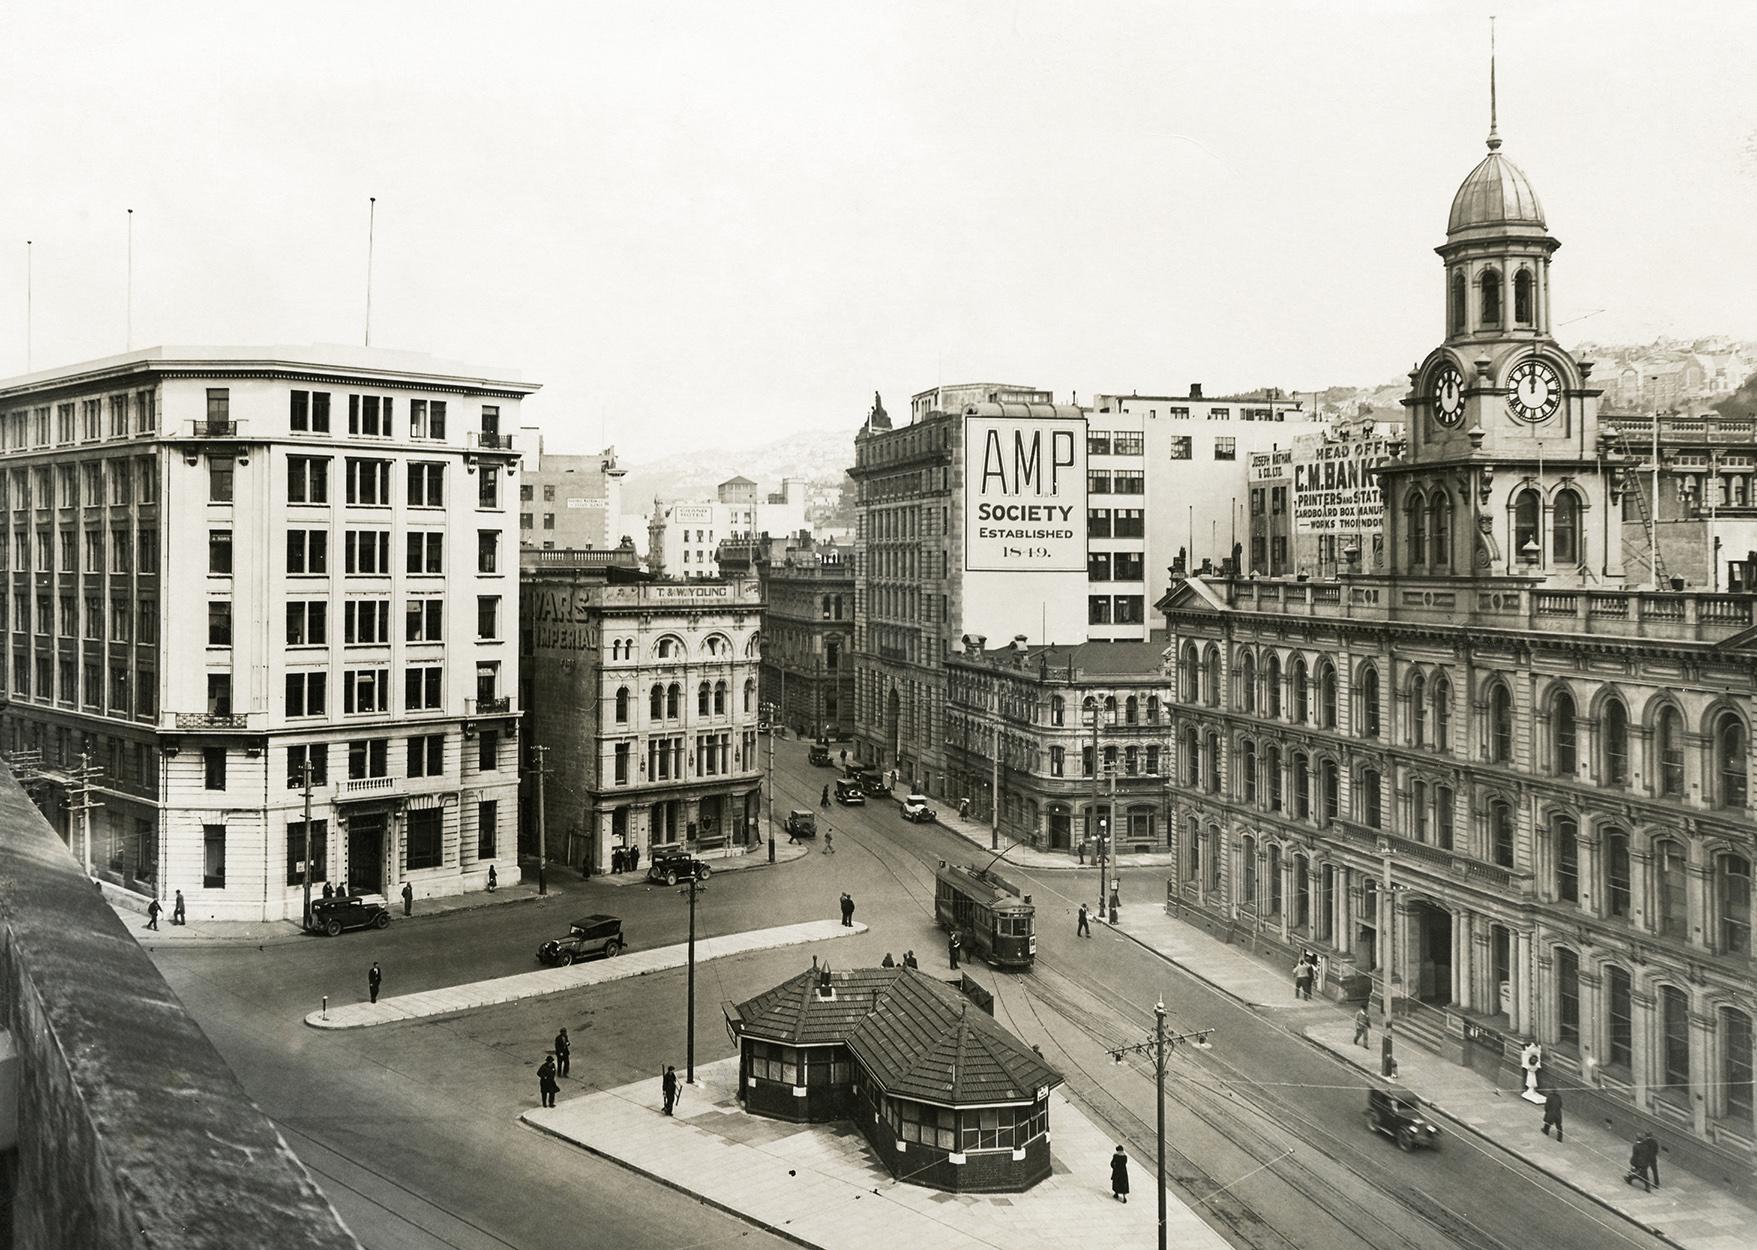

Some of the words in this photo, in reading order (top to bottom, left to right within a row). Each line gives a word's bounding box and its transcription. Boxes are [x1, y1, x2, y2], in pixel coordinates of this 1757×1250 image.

[1316, 446, 1349, 460] HEAD
[1252, 455, 1270, 467] JOSEPH
[1298, 493, 1342, 507] PRINTERS
[978, 503, 1074, 521] SOCIETY
[1295, 507, 1338, 518] CARDBOARD
[1340, 507, 1355, 516] BOX
[979, 528, 1073, 539] ESTABLISHED
[667, 588, 673, 597] &
[689, 588, 727, 597] YOUNG
[536, 626, 598, 652] IMPERIAL
